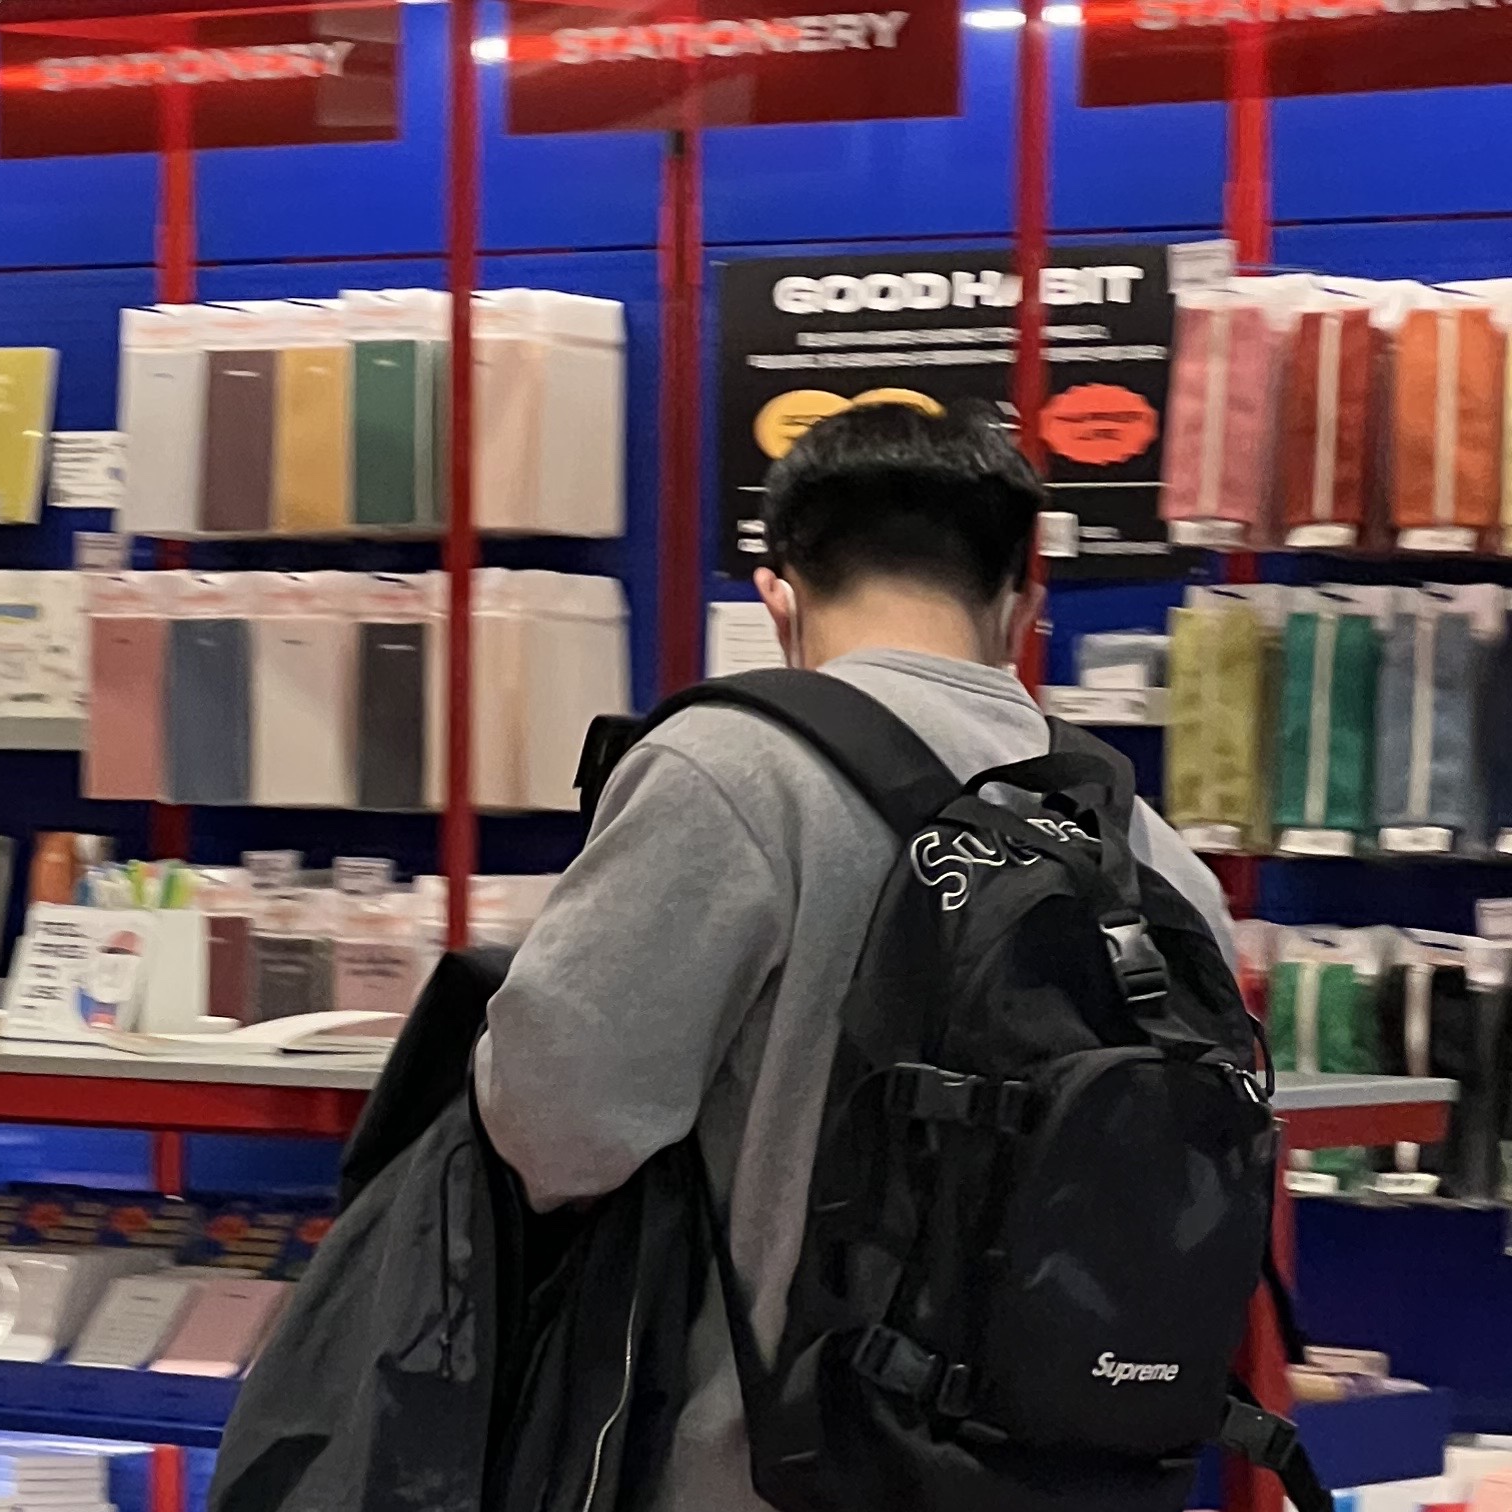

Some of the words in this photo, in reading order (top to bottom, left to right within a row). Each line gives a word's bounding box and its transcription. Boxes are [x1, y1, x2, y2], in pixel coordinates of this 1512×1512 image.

[552, 11, 910, 64] STATIONERY
[38, 41, 356, 92] STATIONERY
[1092, 1351, 1180, 1387] Supreme
